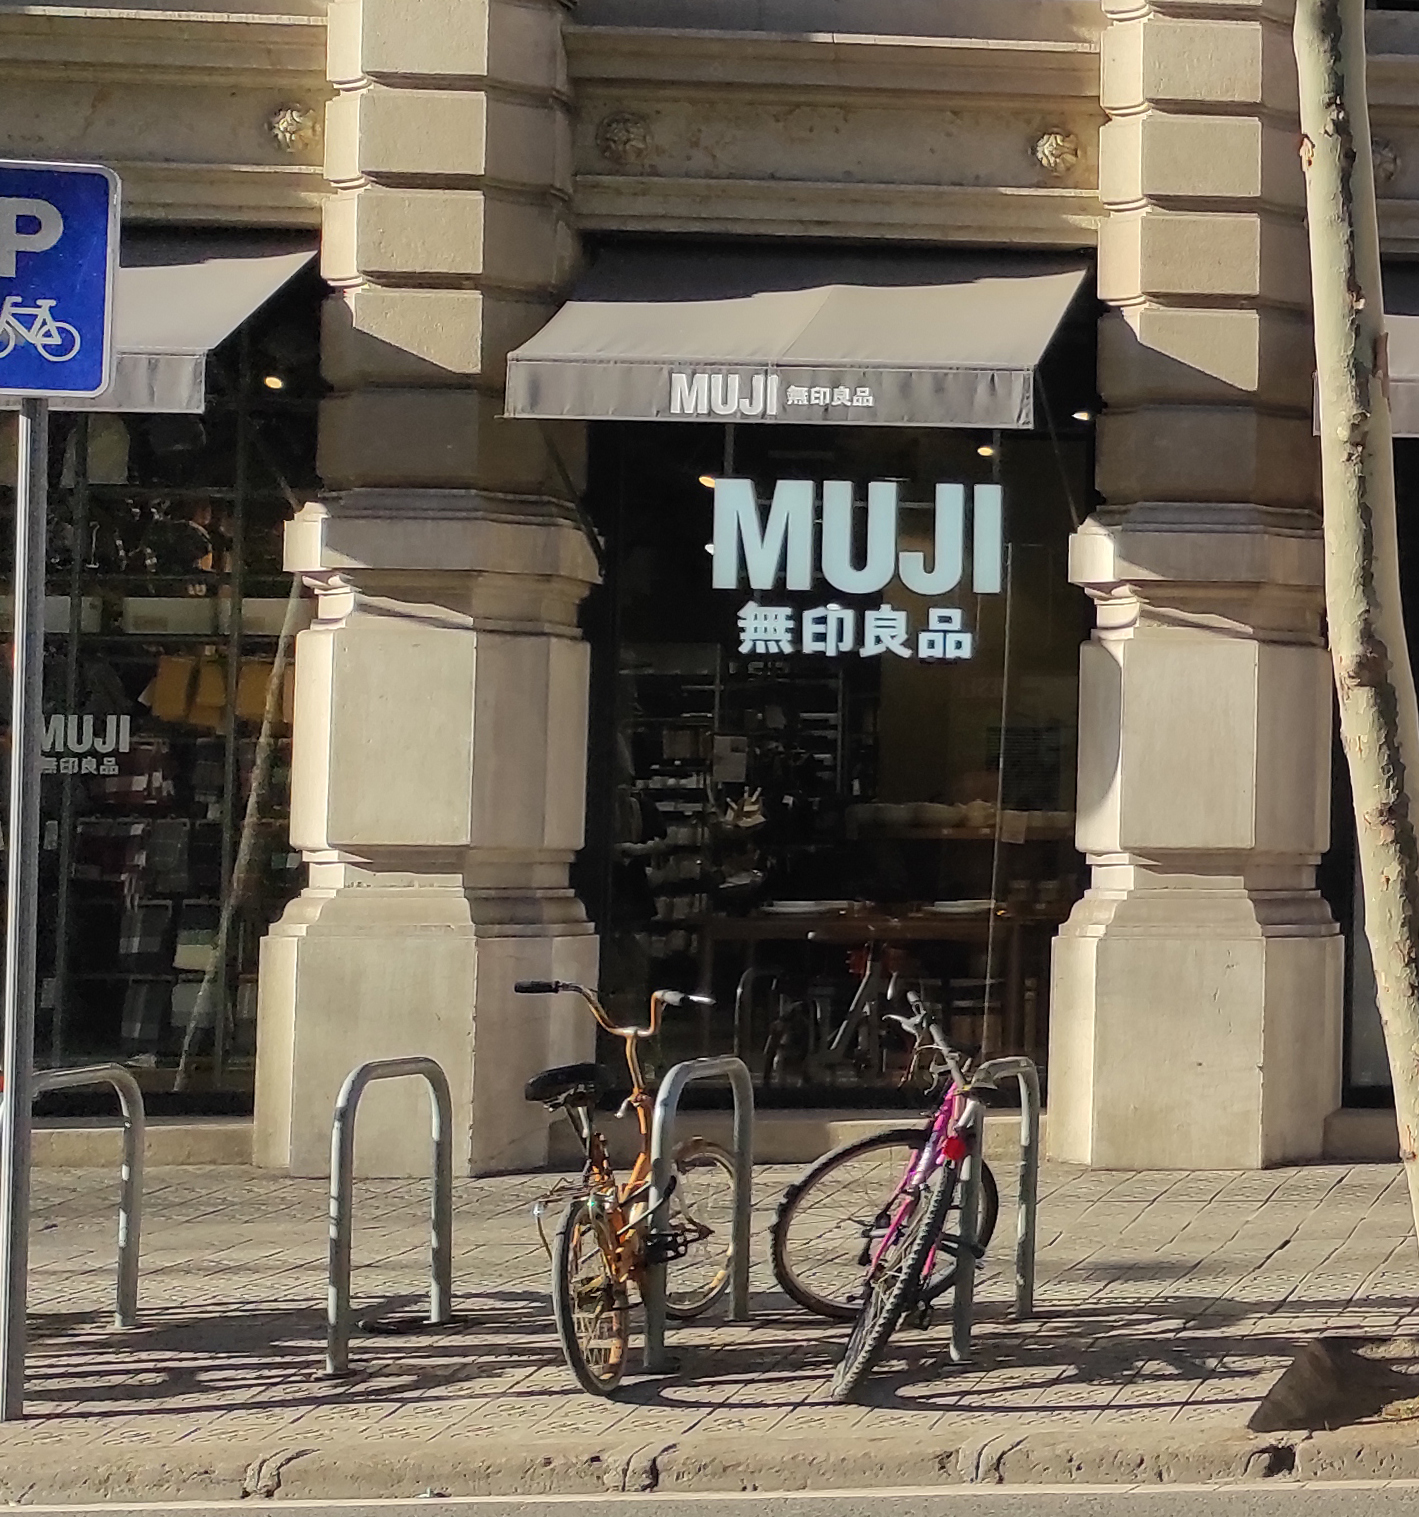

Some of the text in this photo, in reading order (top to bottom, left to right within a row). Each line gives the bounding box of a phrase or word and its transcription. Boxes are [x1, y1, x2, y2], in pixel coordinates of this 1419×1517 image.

[0, 197, 63, 277] P
[670, 373, 874, 415] MUJI 無印良品
[712, 478, 1003, 596] MUJI
[737, 600, 972, 660] 無印良品
[40, 714, 131, 753] MUJI
